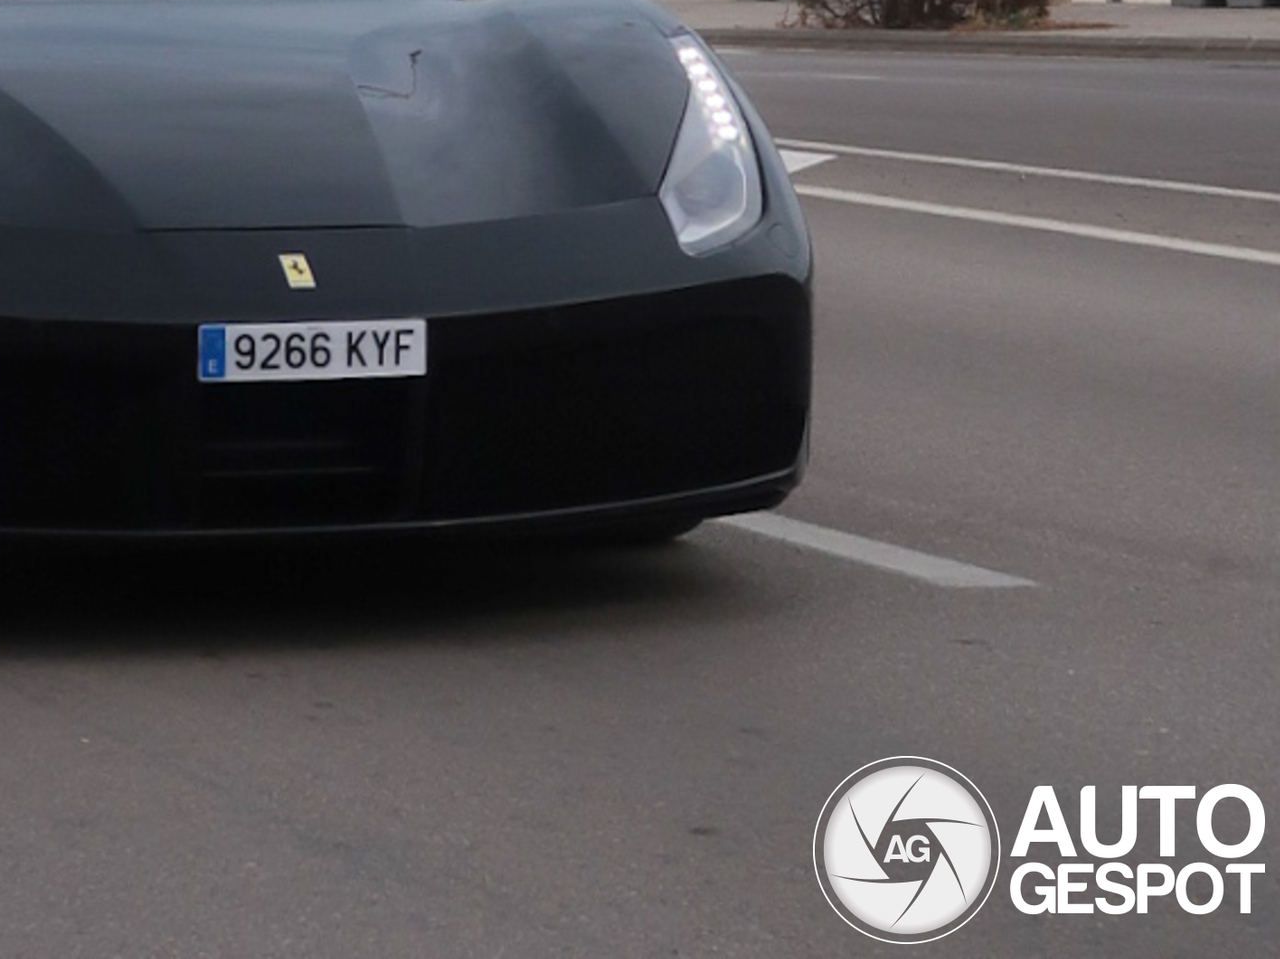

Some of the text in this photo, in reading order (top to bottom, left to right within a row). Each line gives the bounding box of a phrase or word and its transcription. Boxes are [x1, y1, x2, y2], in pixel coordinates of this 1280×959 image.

[233, 328, 415, 371] 9266 KYF
[207, 358, 219, 374] E
